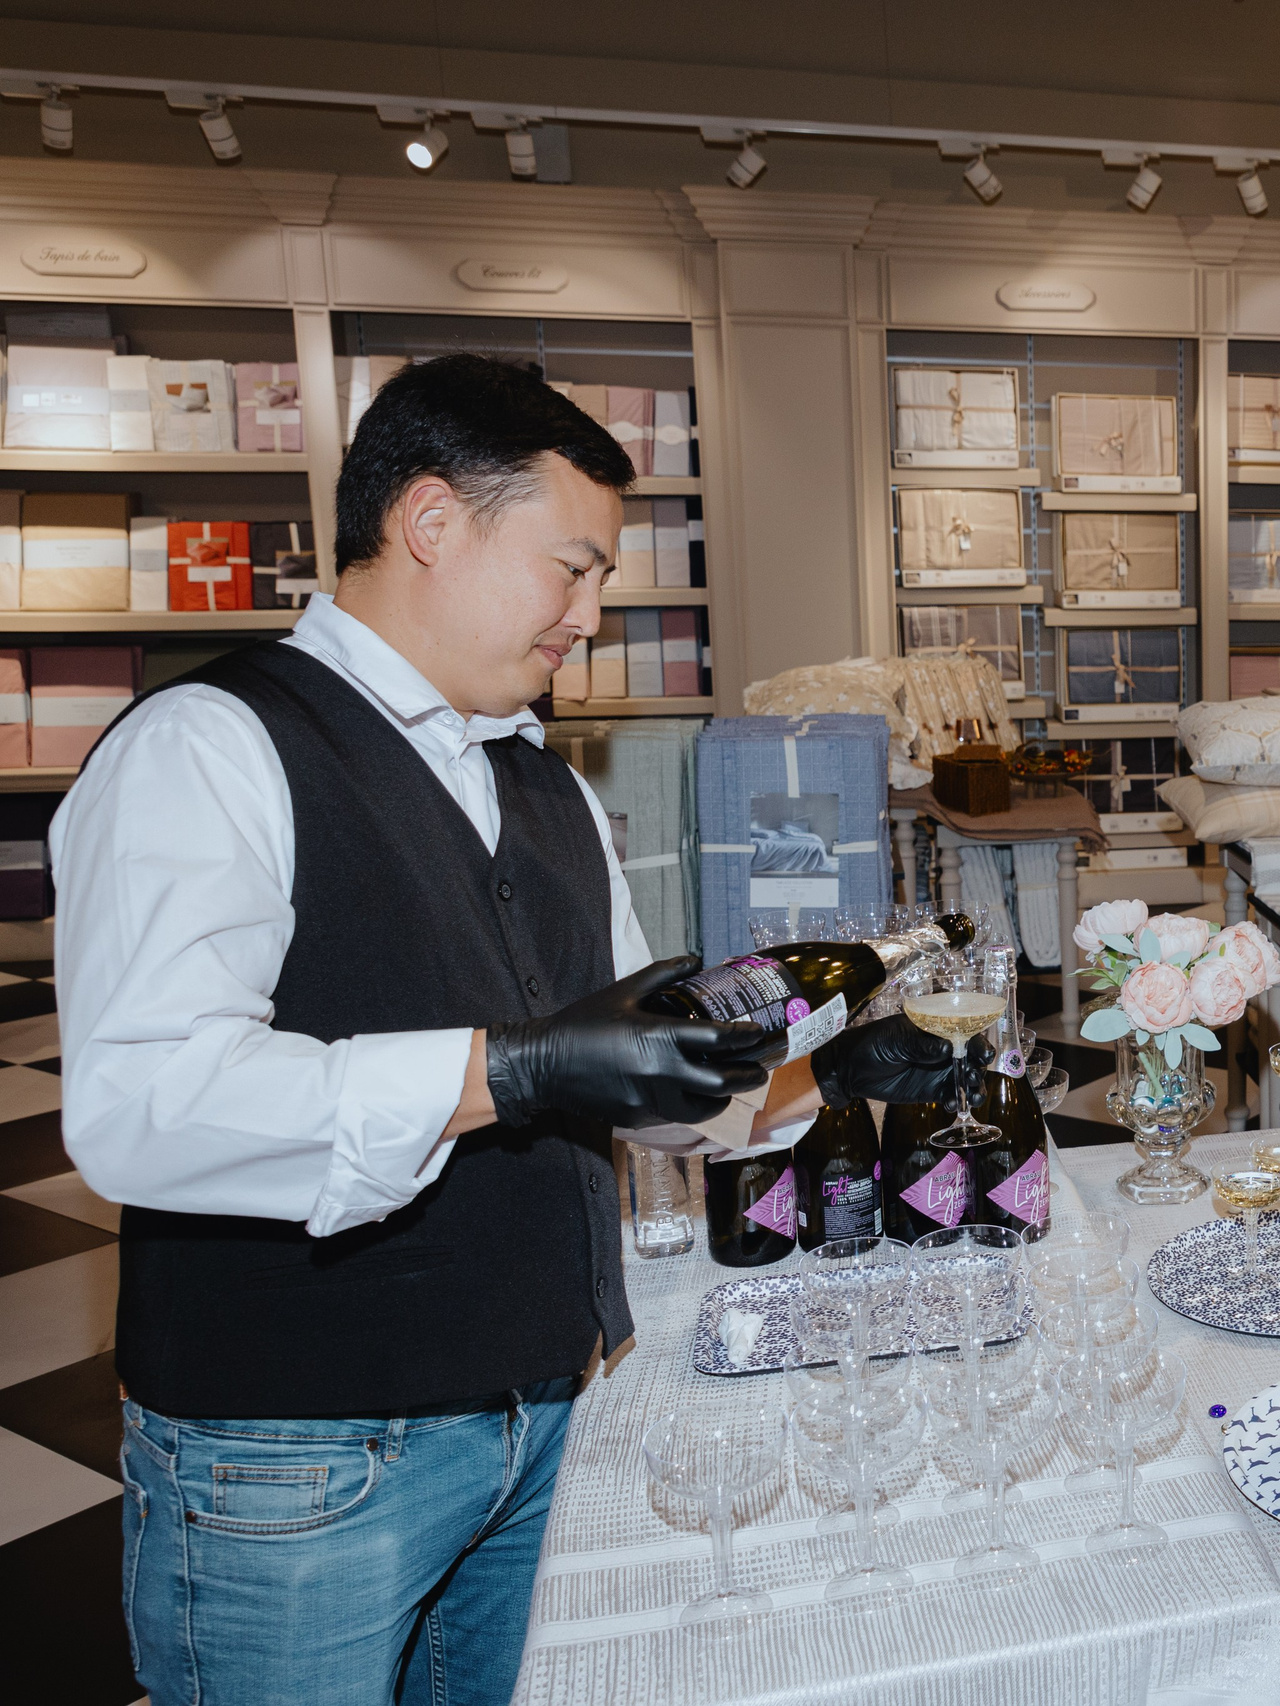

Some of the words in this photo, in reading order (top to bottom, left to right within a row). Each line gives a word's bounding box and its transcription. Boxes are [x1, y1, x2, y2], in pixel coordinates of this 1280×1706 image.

[40, 246, 75, 265] Tapis
[77, 249, 90, 261] de
[94, 248, 120, 262] bain
[822, 1175, 853, 1206] Light
